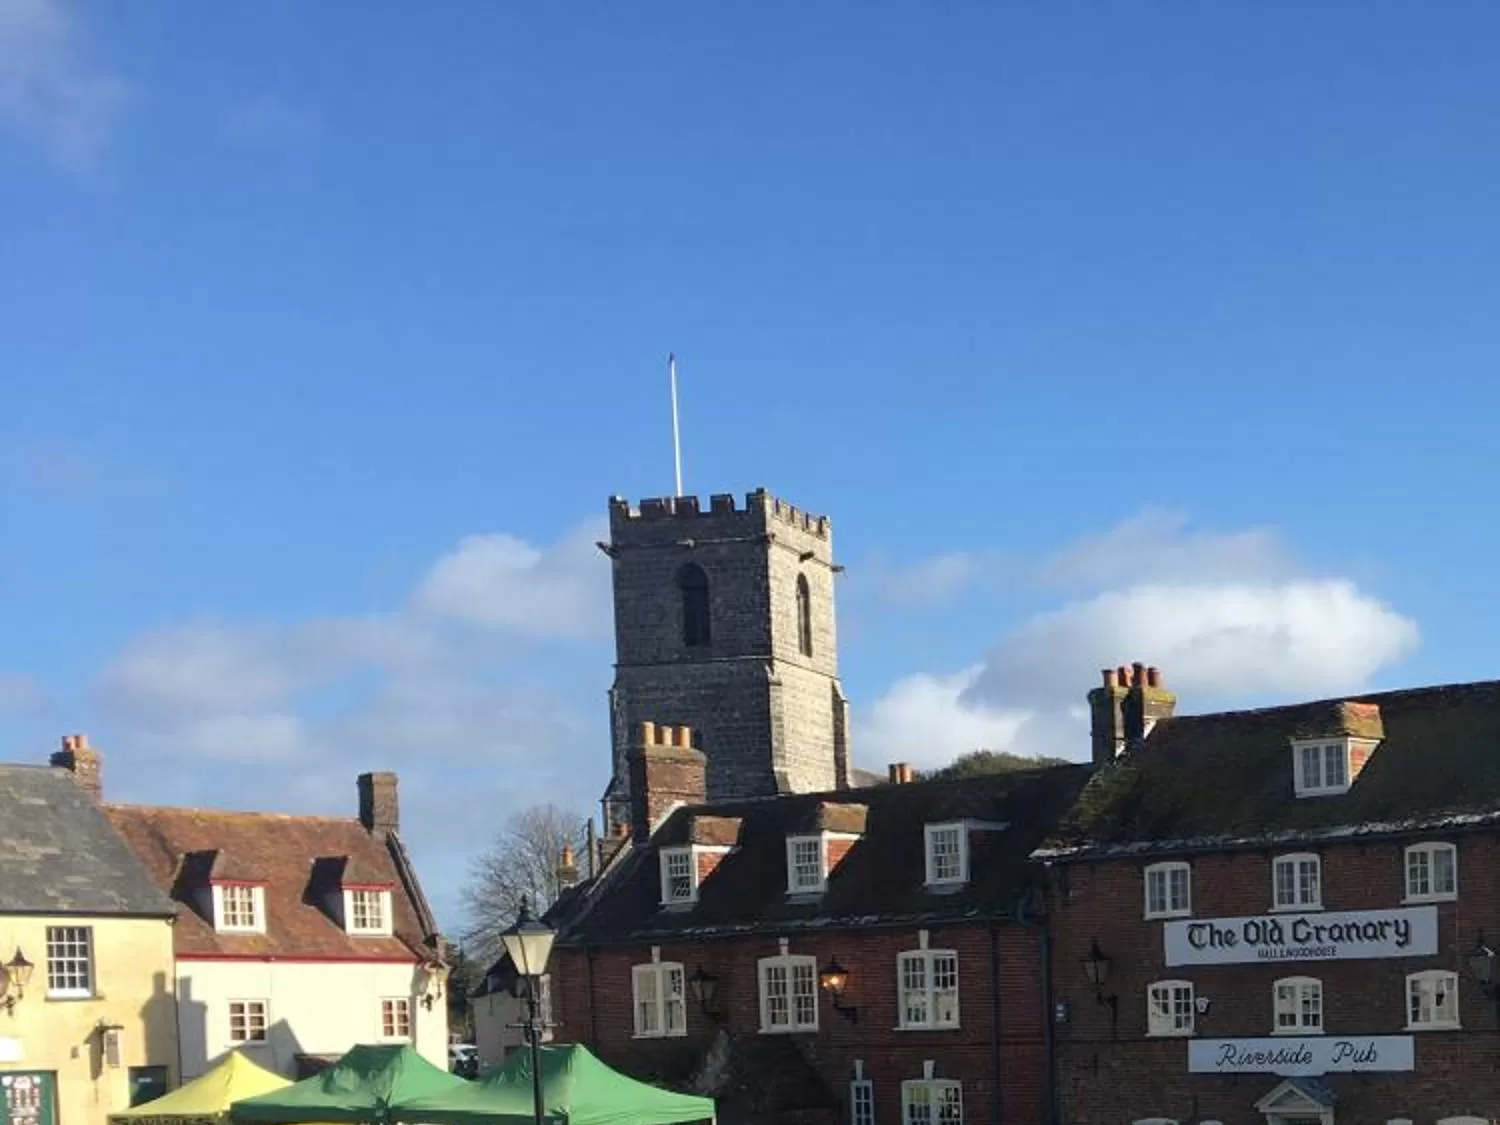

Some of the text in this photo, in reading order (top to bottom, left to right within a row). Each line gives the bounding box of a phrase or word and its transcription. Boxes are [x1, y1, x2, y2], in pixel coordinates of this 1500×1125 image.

[1187, 916, 1410, 950] The Old Granary
[1215, 1041, 1378, 1067] Riverside Pub
